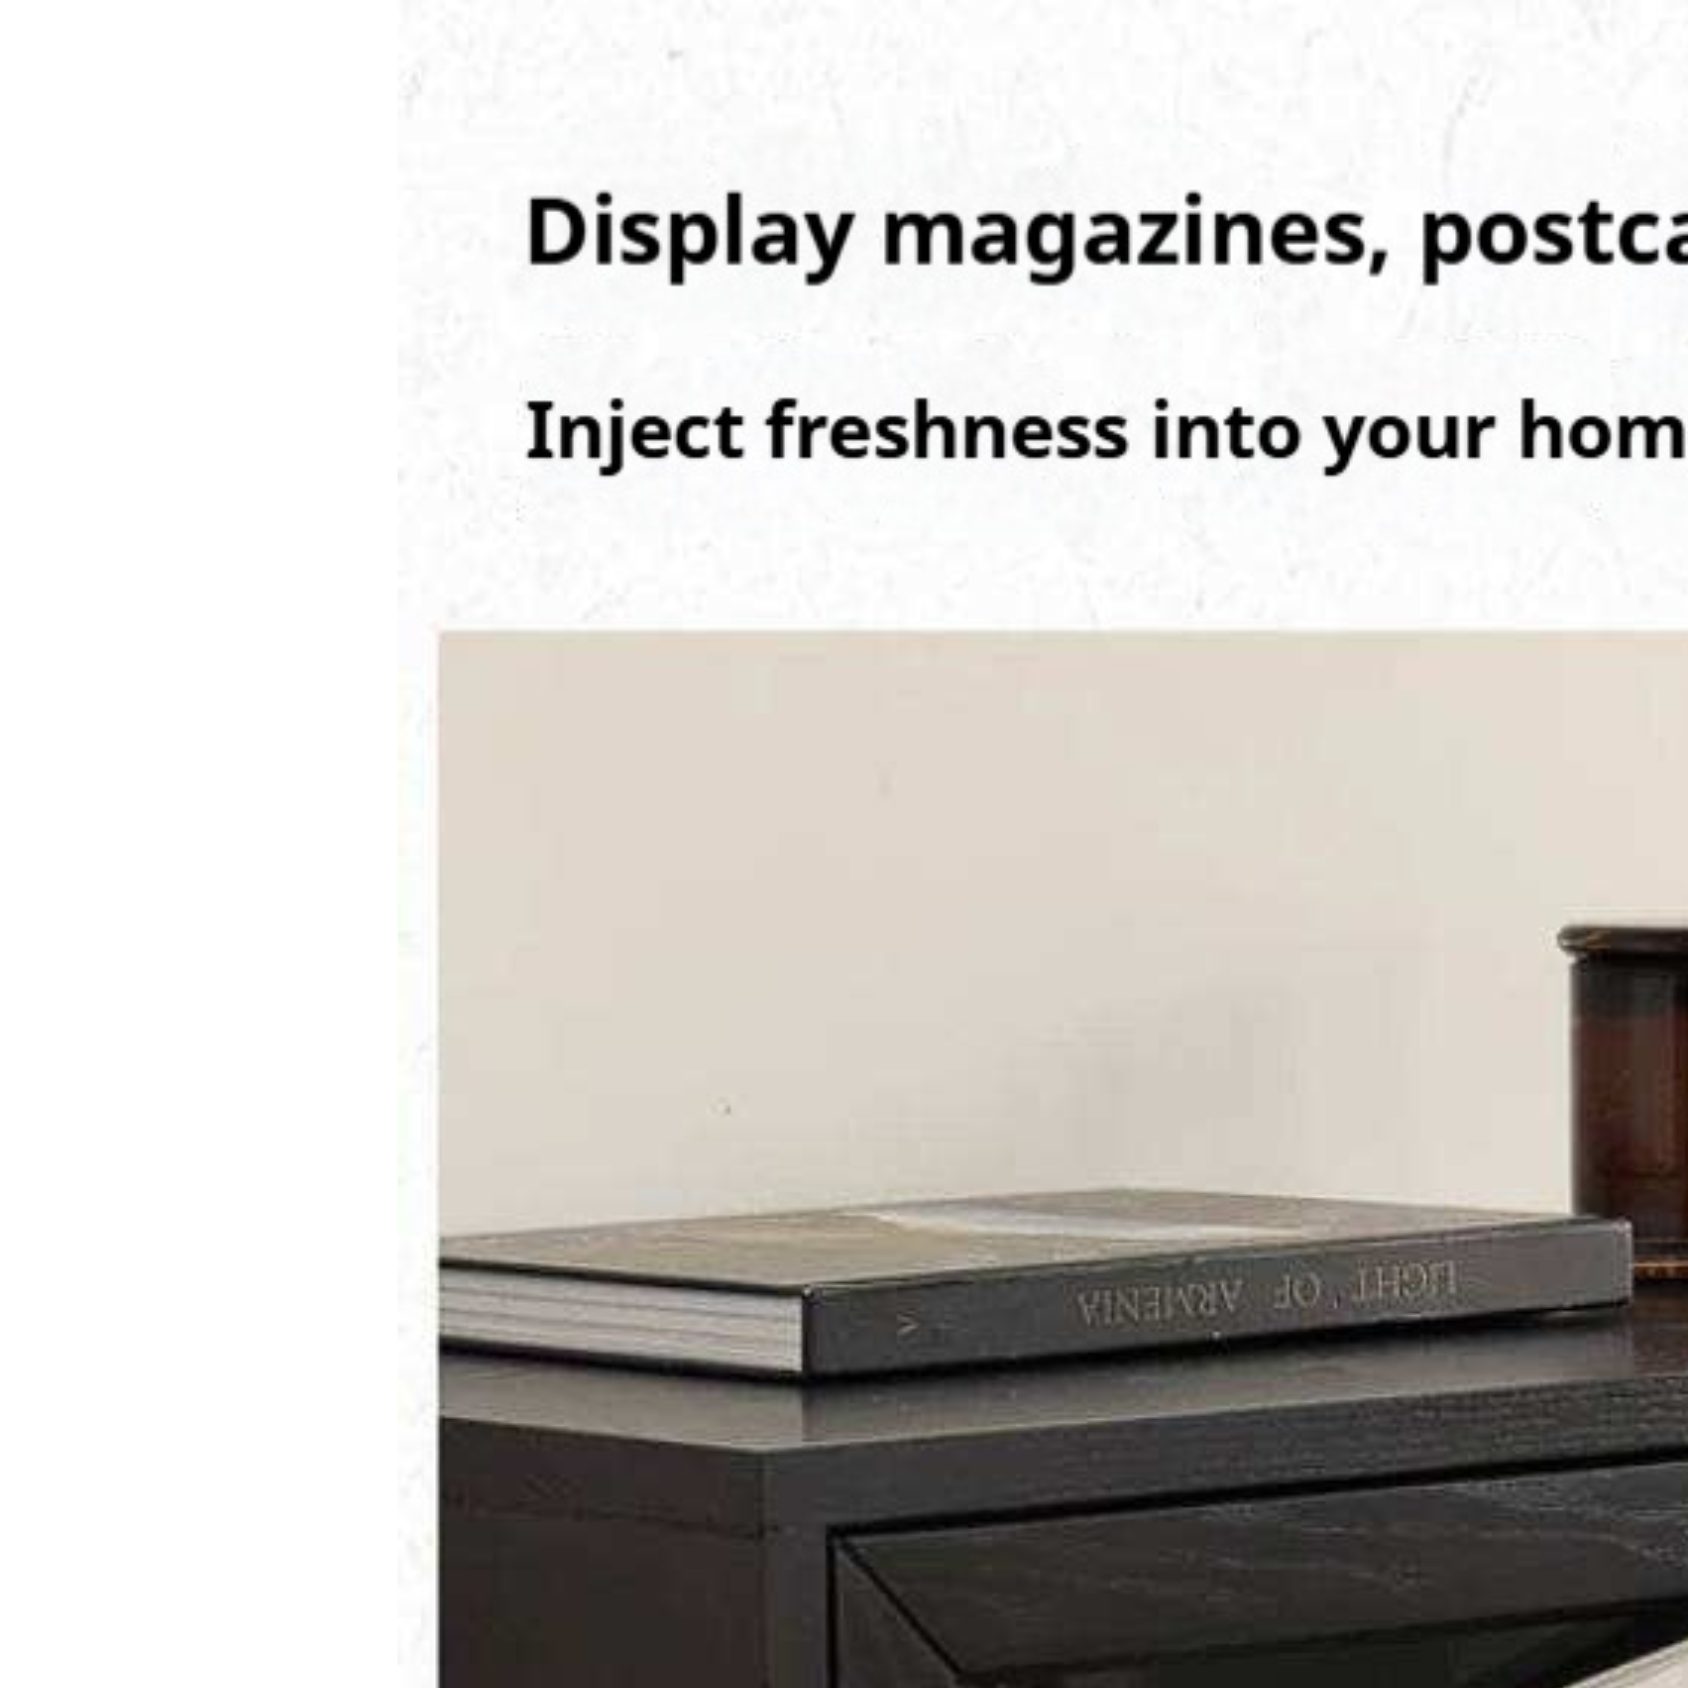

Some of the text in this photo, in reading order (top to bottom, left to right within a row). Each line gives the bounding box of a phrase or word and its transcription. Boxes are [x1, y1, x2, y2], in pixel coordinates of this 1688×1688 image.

[1077, 1259, 1459, 1327] LIGHT OF ARMENIA
